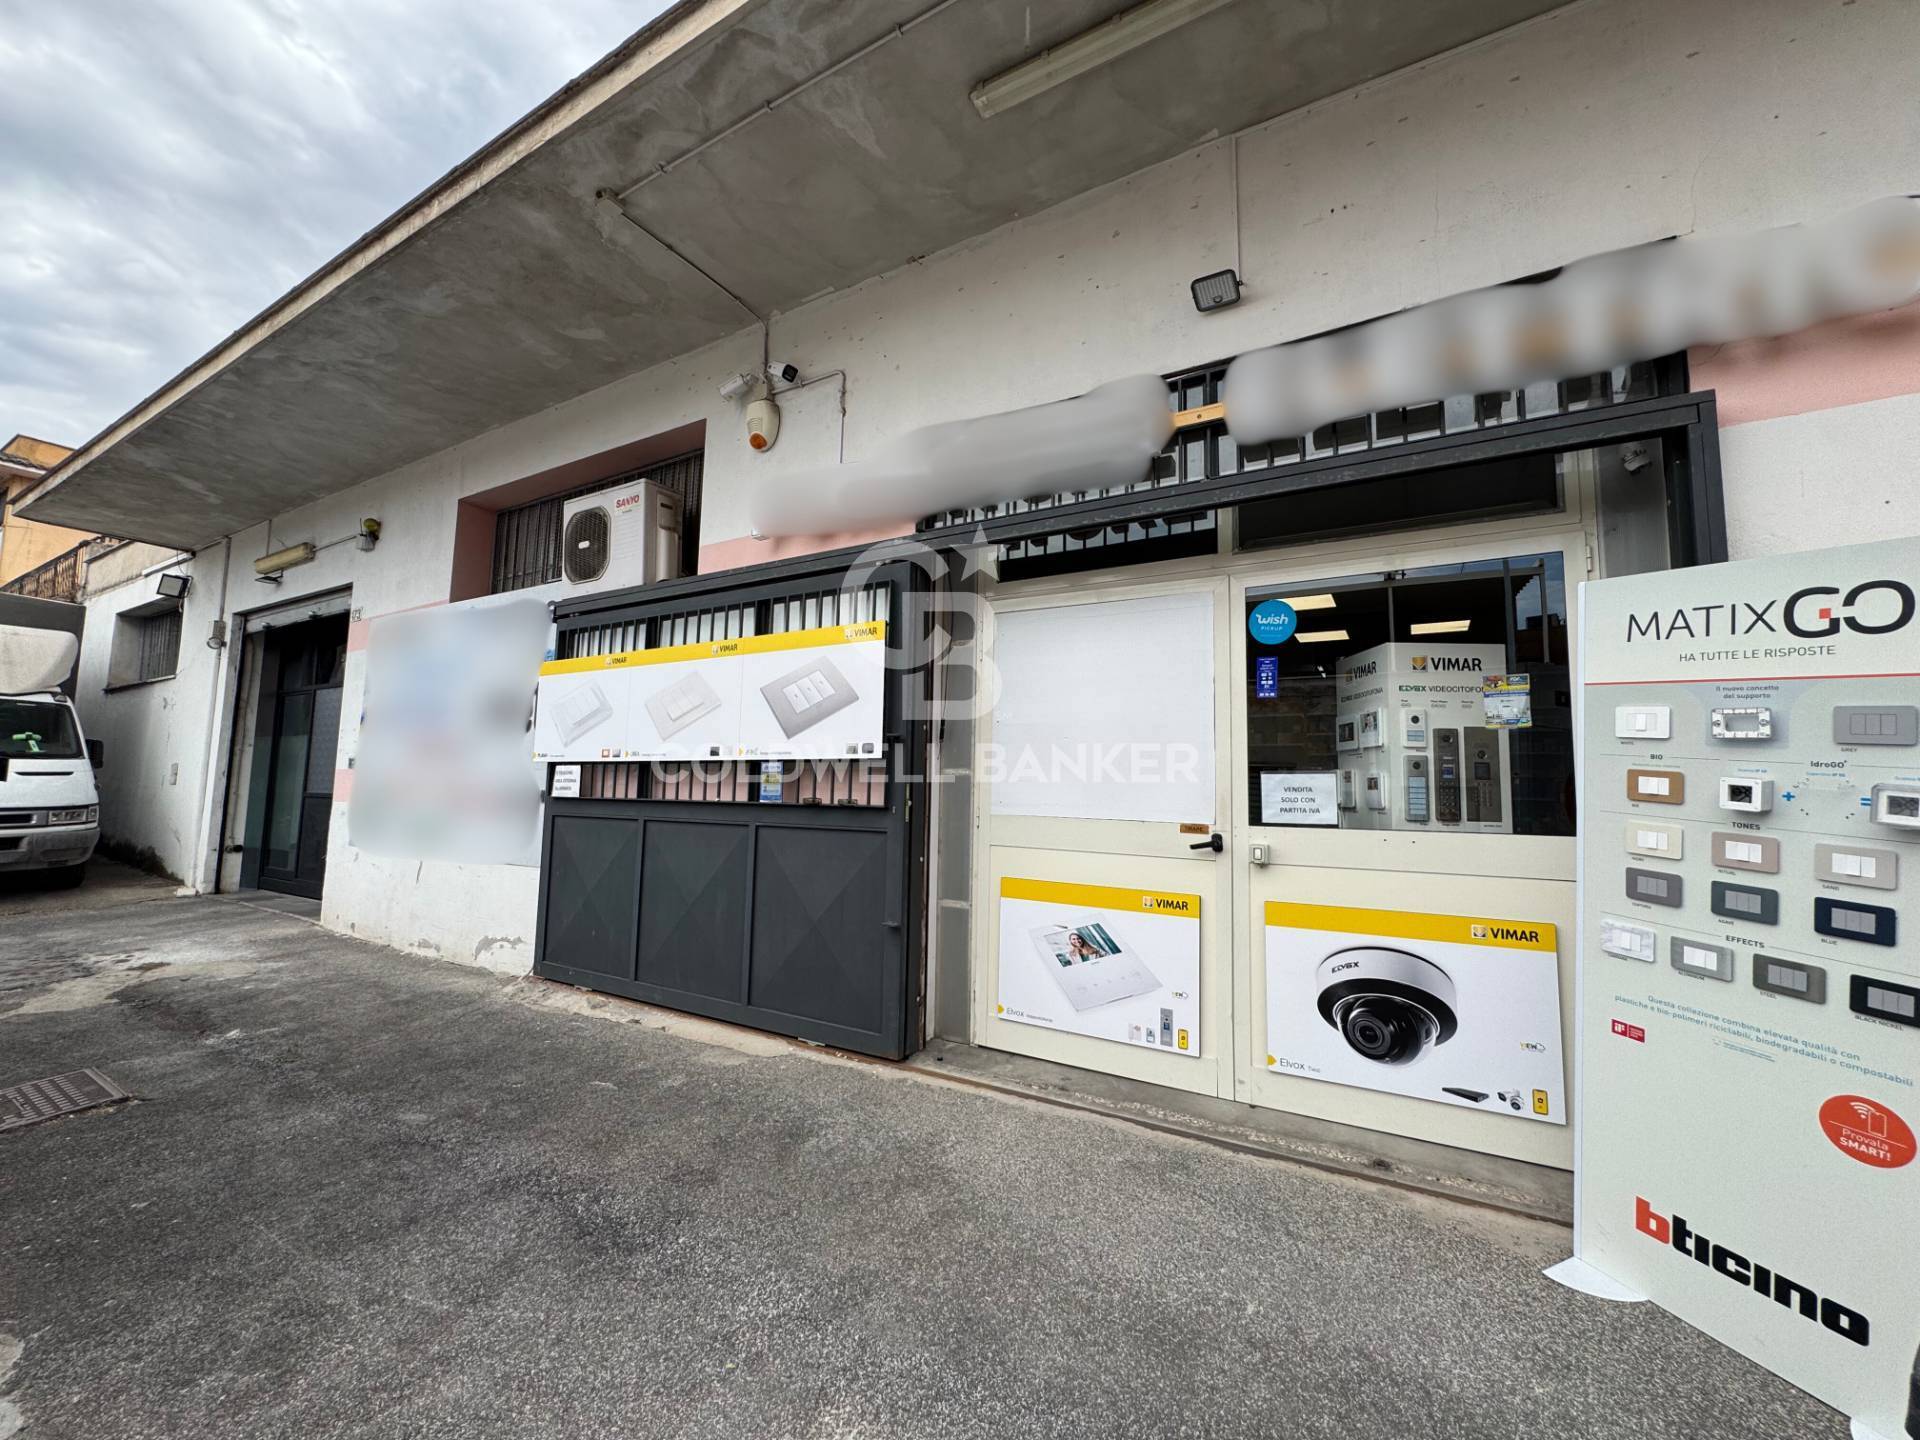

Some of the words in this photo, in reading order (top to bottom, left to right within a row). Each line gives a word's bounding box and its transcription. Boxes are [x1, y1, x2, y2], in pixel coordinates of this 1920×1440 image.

[616, 494, 640, 509] SANYO
[1255, 613, 1289, 625] wish
[854, 626, 878, 638] VIMAR
[719, 643, 738, 653] VIMAR
[1679, 653, 1697, 663] HA
[1699, 650, 1739, 662] TUTTE
[1742, 649, 1761, 659] LE
[1763, 644, 1837, 658] RISPOSTE
[1353, 660, 1377, 680] VIMAR
[1430, 657, 1483, 672] VIMAR
[1649, 753, 1663, 761] BIO
[1280, 796, 1299, 804] SOLO
[1731, 821, 1761, 831] TONES
[1155, 898, 1189, 911] VIMAR
[1489, 927, 1540, 944] VIMAR
[1725, 934, 1766, 949] EFFECTS
[1006, 1007, 1025, 1018] Elvox
[1854, 1014, 1878, 1025] BLACK
[1647, 994, 1675, 1010] Questa
[1677, 1004, 1720, 1022] collezione
[1721, 1016, 1761, 1034] combina
[1763, 1029, 1799, 1045] elevata
[1840, 1050, 1861, 1062] con
[1614, 995, 1649, 1010] plastiche
[1755, 1034, 1828, 1063] biodegradabili
[1829, 1057, 1837, 1065] o
[1839, 1061, 1914, 1088] compostabili
[1279, 1057, 1306, 1071] Elvox
[1842, 1127, 1889, 1152] Provala
[1839, 1136, 1892, 1162] SMART!
